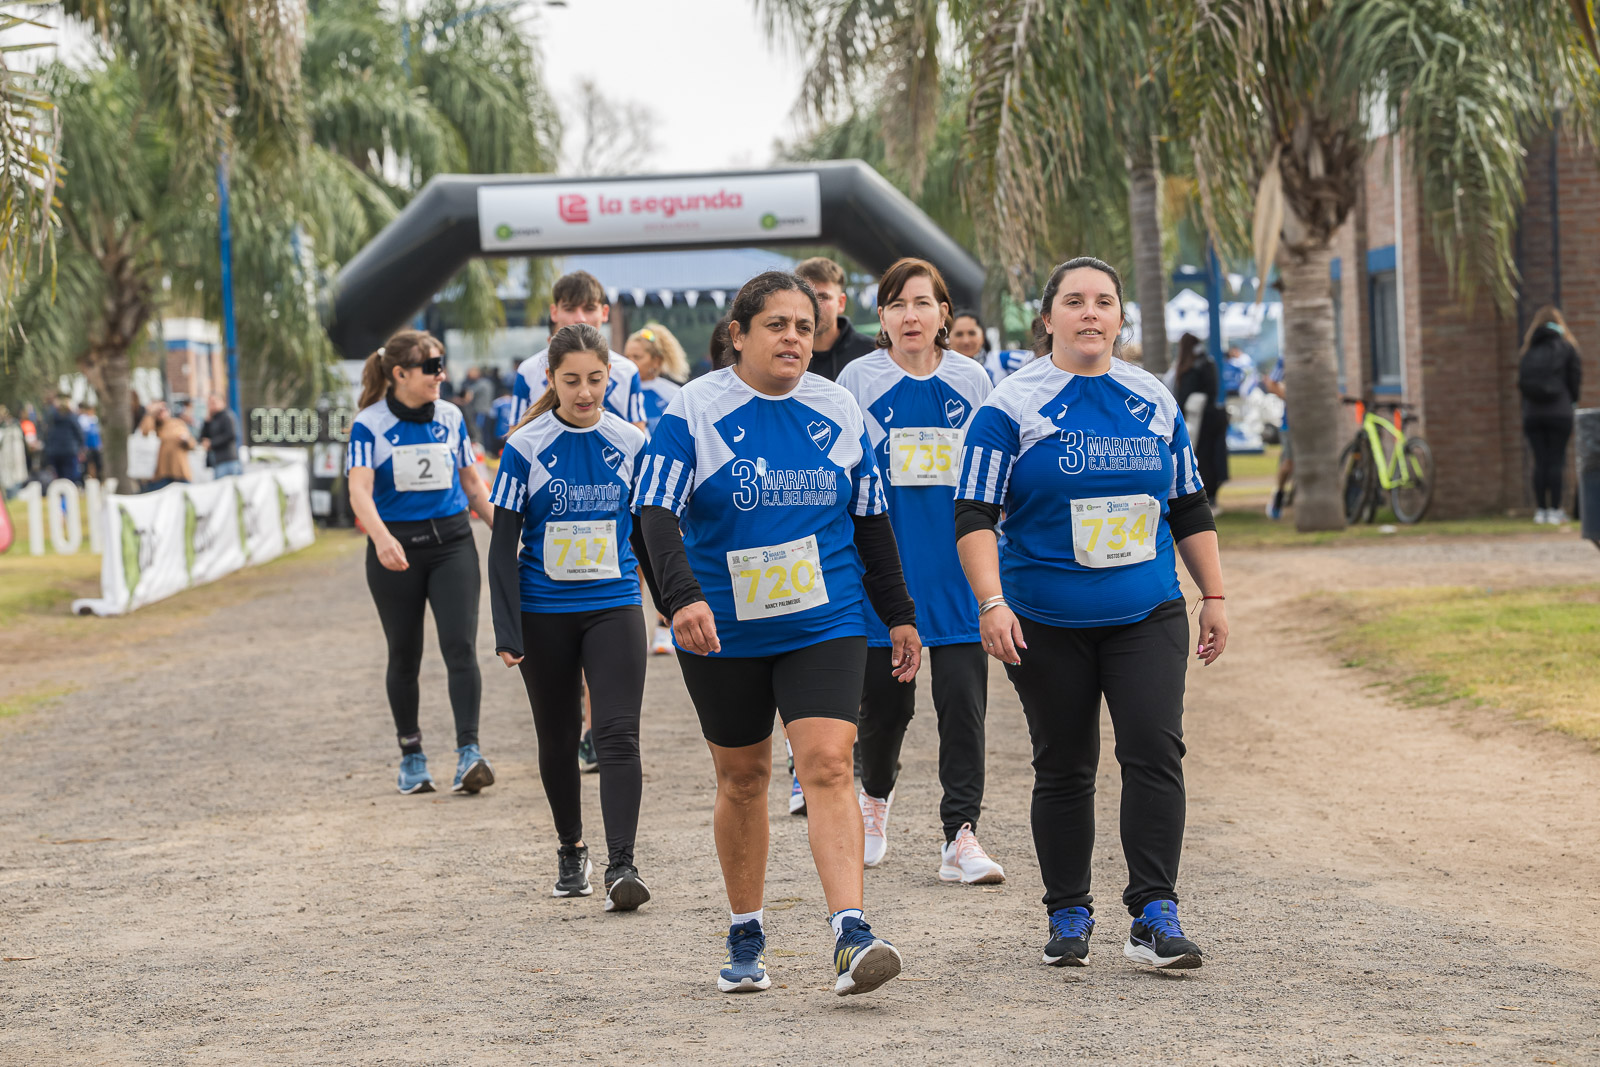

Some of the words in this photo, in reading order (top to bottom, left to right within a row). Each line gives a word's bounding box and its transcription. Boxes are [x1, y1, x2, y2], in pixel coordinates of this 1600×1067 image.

[598, 194, 622, 214] la
[630, 189, 743, 217] segunda
[898, 444, 952, 472] 735
[1059, 429, 1085, 474] 3
[417, 458, 433, 479] 2
[761, 466, 837, 491] MARATÓN
[548, 478, 568, 516] 3
[568, 482, 621, 501] MARATÓN
[731, 458, 760, 511] 3
[1081, 513, 1149, 553] 734
[553, 537, 608, 567] 717
[740, 559, 816, 604] 720
